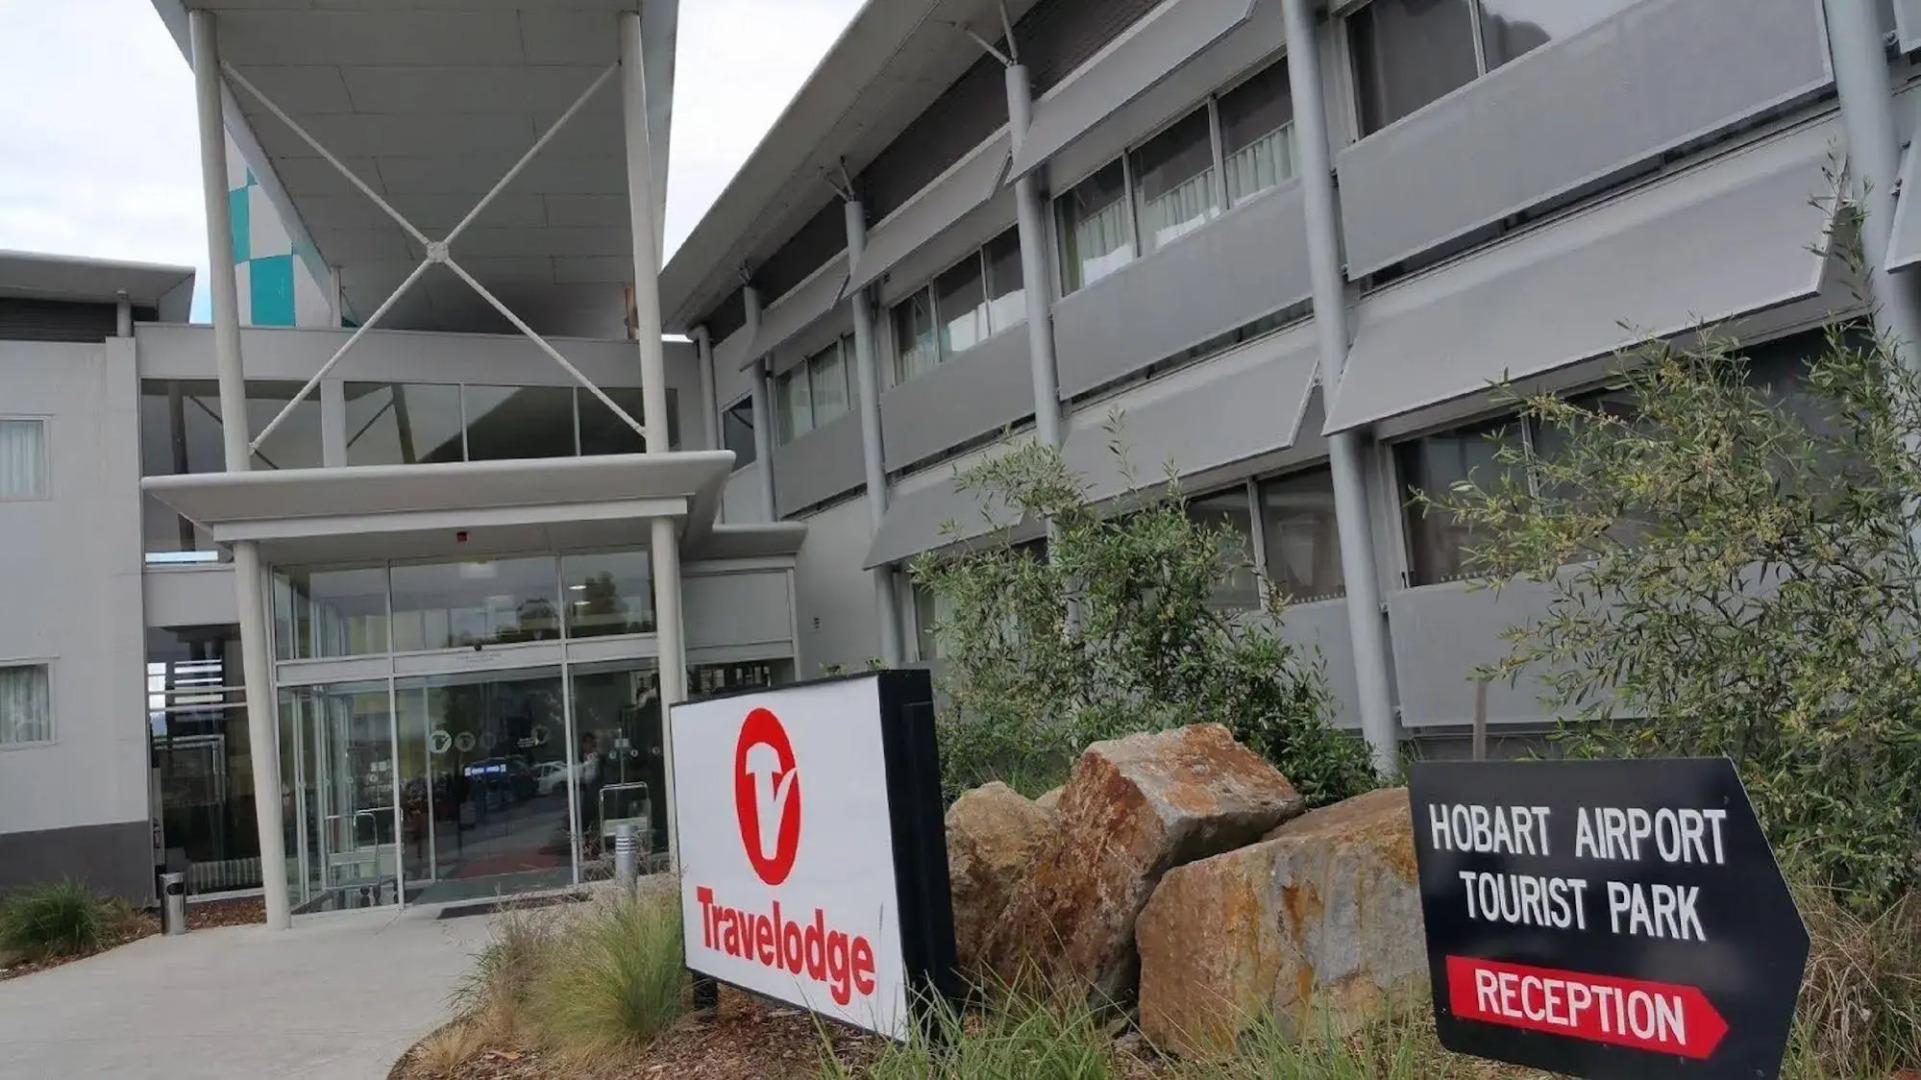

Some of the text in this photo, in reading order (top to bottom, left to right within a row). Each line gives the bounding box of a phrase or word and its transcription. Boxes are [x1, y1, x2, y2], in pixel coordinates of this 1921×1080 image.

[1429, 803, 1727, 865] HOBART AIRPORT
[1459, 870, 1707, 941] TOURIST PARK
[696, 886, 876, 1006] Travelodge
[1475, 968, 1687, 1046] RECEPTION
